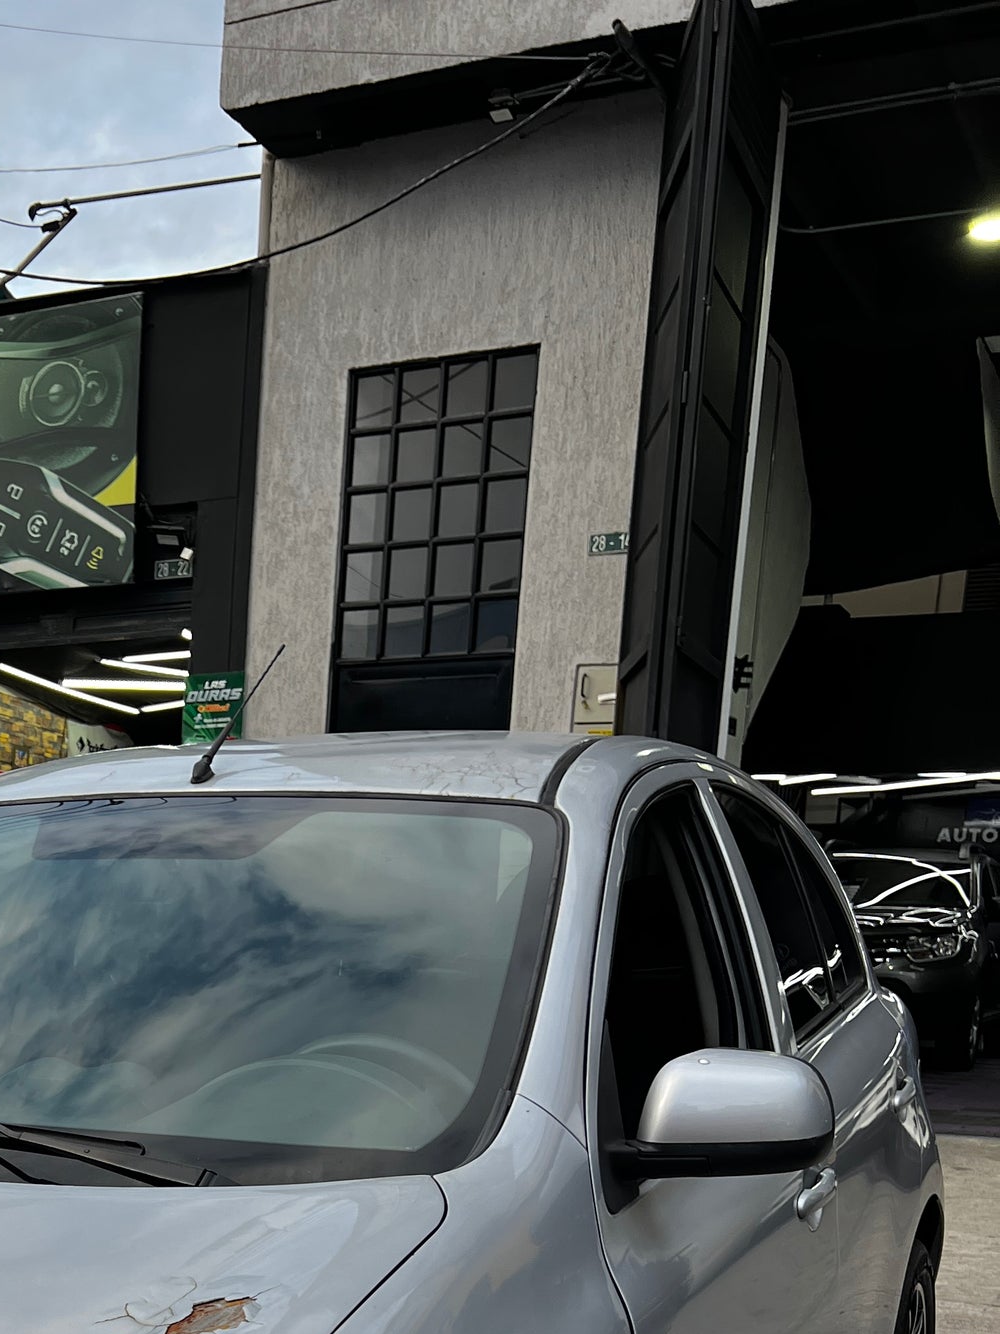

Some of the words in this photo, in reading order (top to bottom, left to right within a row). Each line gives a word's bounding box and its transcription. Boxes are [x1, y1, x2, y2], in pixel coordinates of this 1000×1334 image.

[592, 535, 606, 552] 28
[177, 560, 188, 575] 22
[204, 680, 227, 690] LAS
[186, 687, 243, 703] DURAS
[936, 826, 999, 844] AUTO
